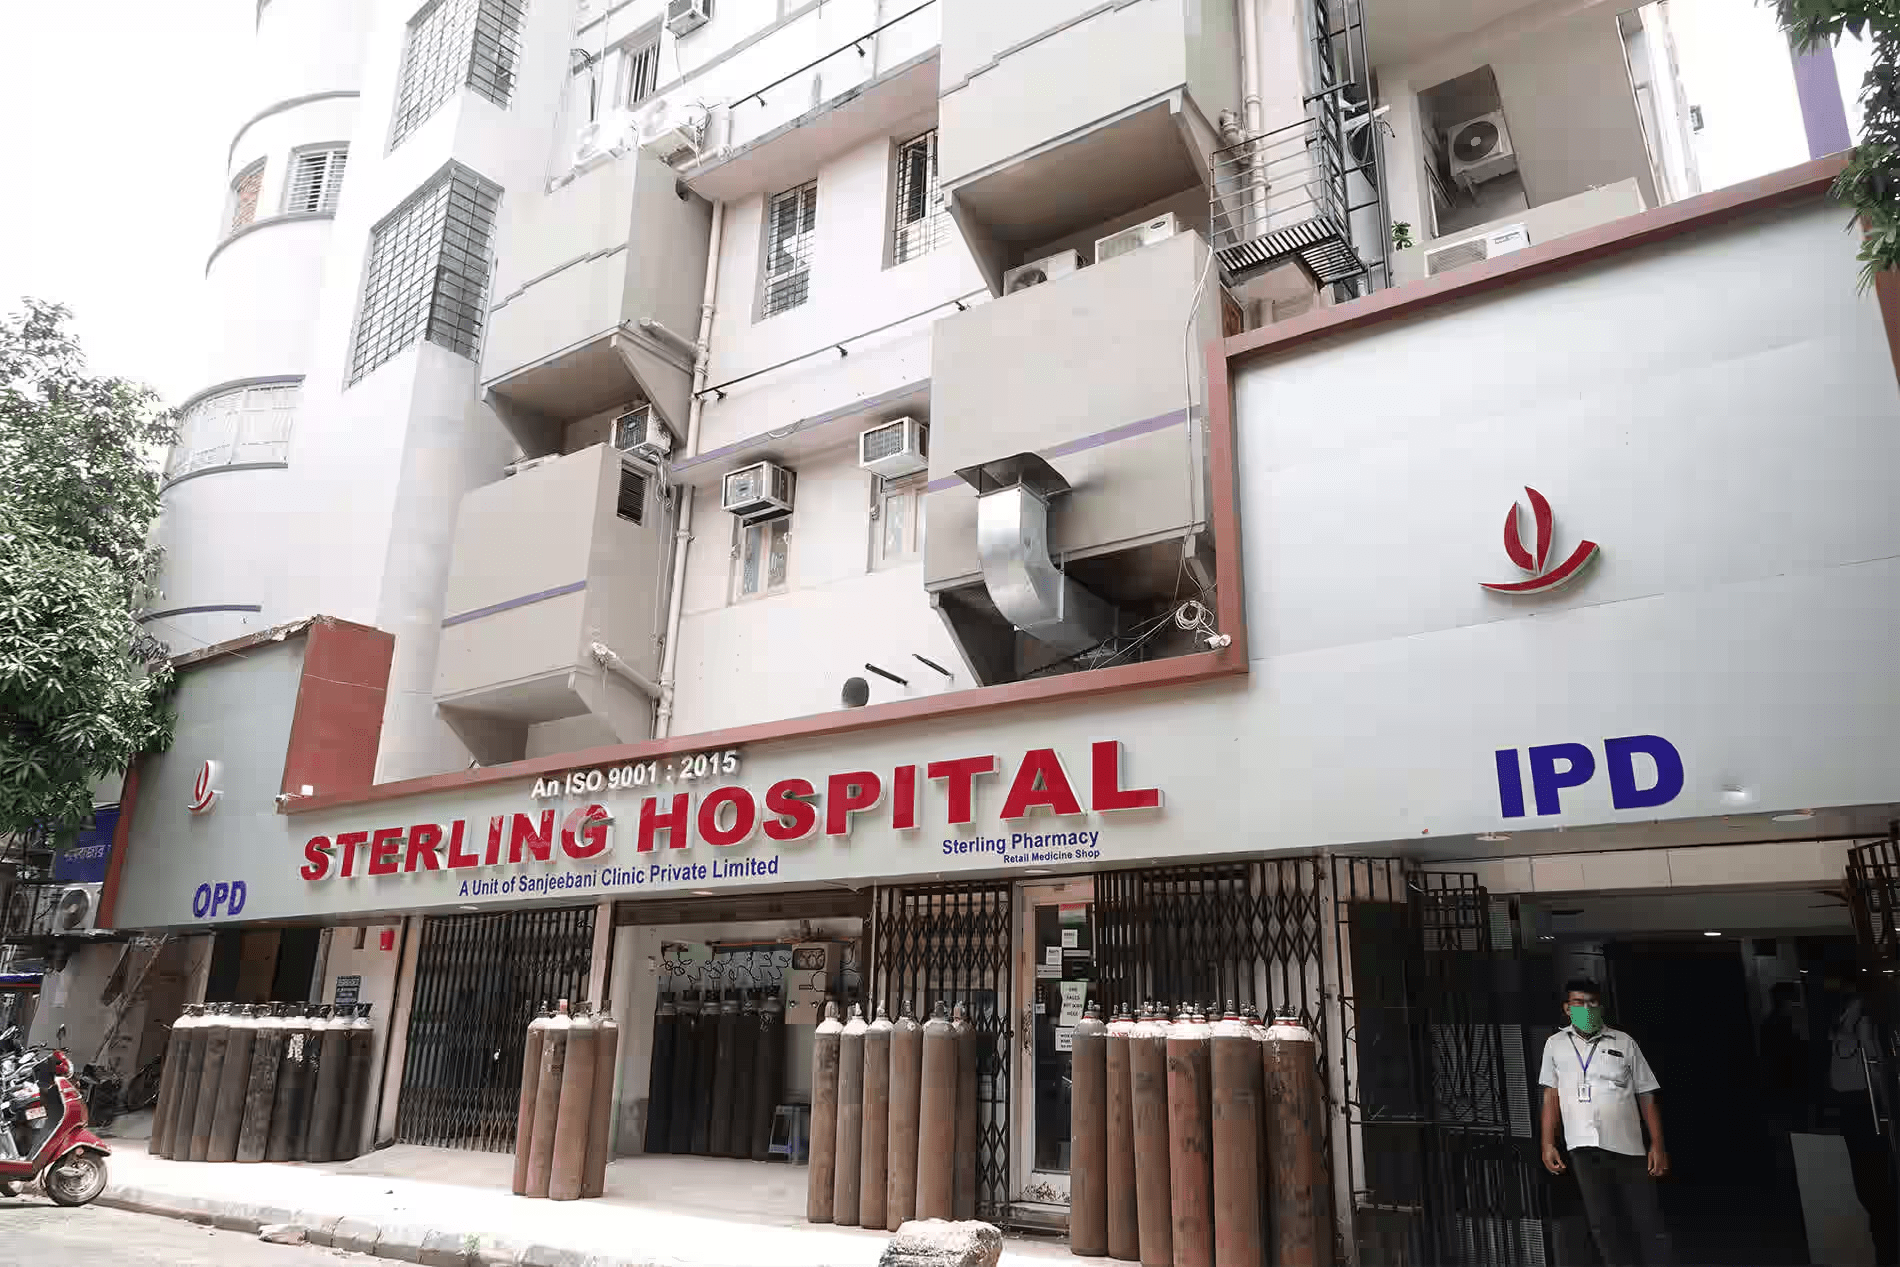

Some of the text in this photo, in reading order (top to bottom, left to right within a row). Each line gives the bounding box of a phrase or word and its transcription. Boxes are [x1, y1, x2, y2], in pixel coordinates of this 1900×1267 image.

[531, 750, 738, 800] An ISO 9001 : 2015
[1495, 734, 1686, 819] IPD
[299, 740, 1163, 882] STERLING HOSPITAL
[942, 831, 1100, 855] Sterling Pharmacy
[1003, 849, 1101, 864] Retail Medicine Shop
[459, 855, 779, 897] A Unit of Sanjeebani Clinic Private Limited
[193, 880, 248, 919] OPD
